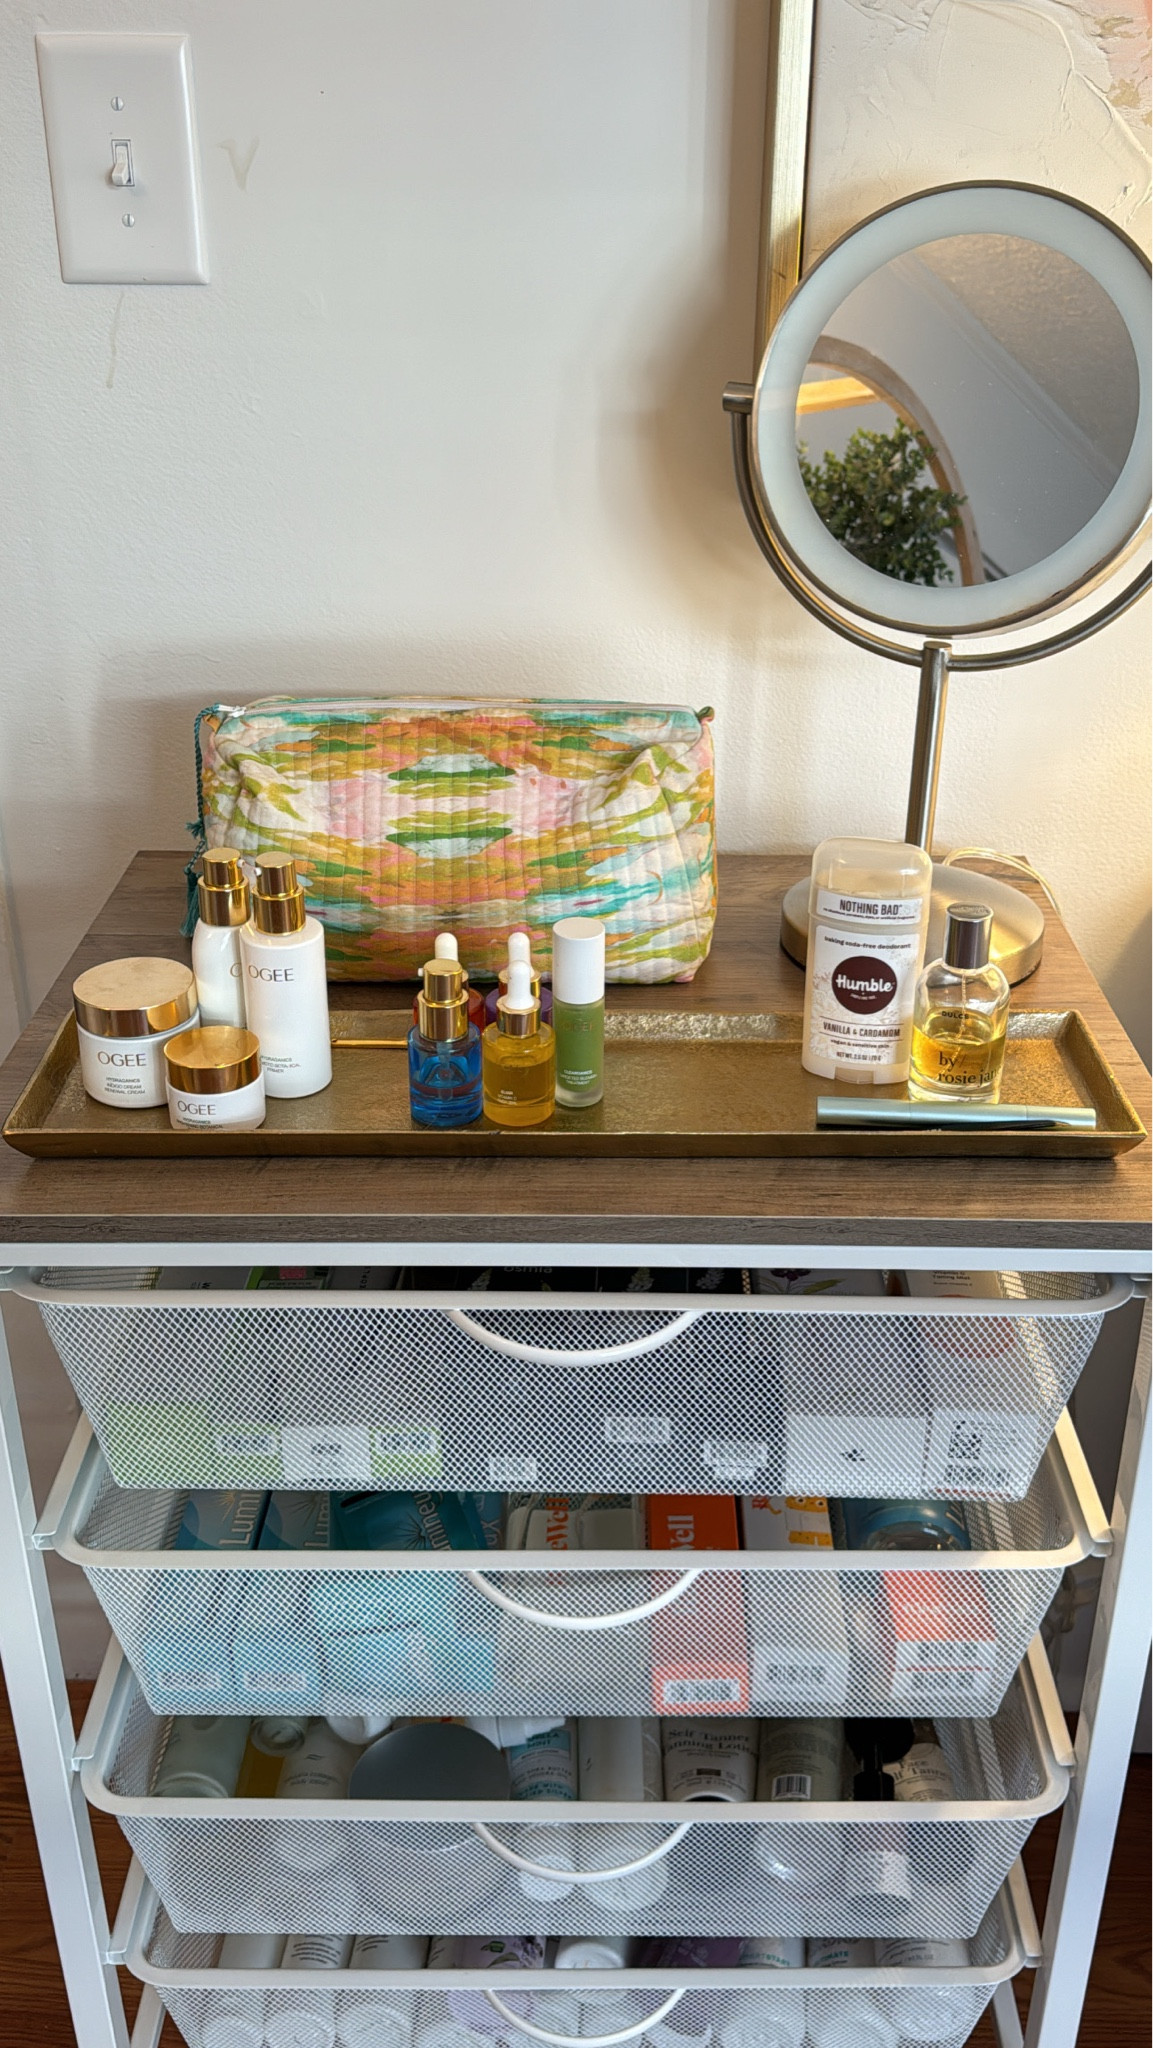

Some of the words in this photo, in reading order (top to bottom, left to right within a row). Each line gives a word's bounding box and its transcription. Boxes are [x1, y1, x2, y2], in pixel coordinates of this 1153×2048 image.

[839, 899, 878, 915] NOTHING
[824, 935, 845, 946] baking
[845, 940, 876, 949] soda-free
[248, 967, 295, 983] OGEE
[835, 973, 893, 992] Humble
[823, 1021, 850, 1035] VANILLA
[859, 1028, 901, 1038] CARDAMOM
[97, 1050, 147, 1067] OGEE
[938, 1071, 977, 1084] rosie
[979, 1068, 1000, 1088] jan
[177, 1100, 217, 1116] OGEE
